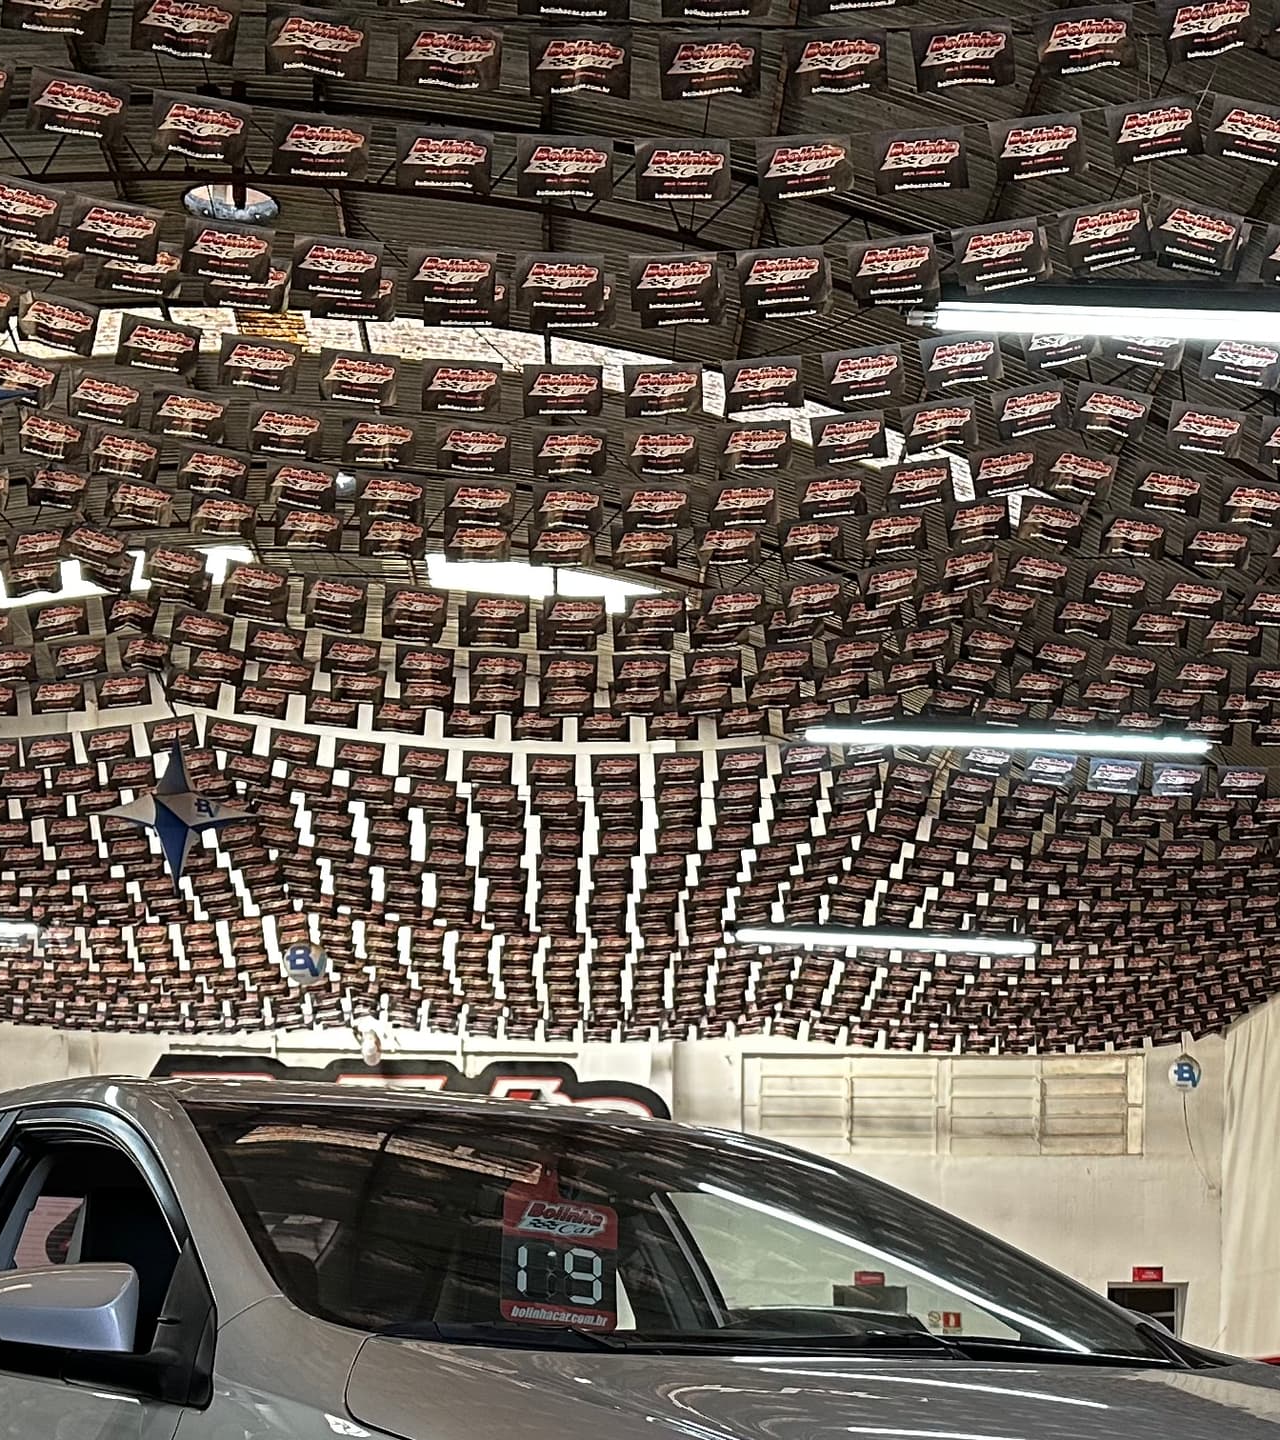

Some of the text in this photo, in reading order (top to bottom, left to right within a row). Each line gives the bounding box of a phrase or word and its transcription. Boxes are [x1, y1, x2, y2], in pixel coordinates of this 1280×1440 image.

[285, 945, 327, 978] BV
[527, 1202, 604, 1227] Bolinha
[558, 1223, 596, 1234] Car
[516, 1246, 602, 1305] 19
[511, 1305, 609, 1327] bolinhacar.com.br
